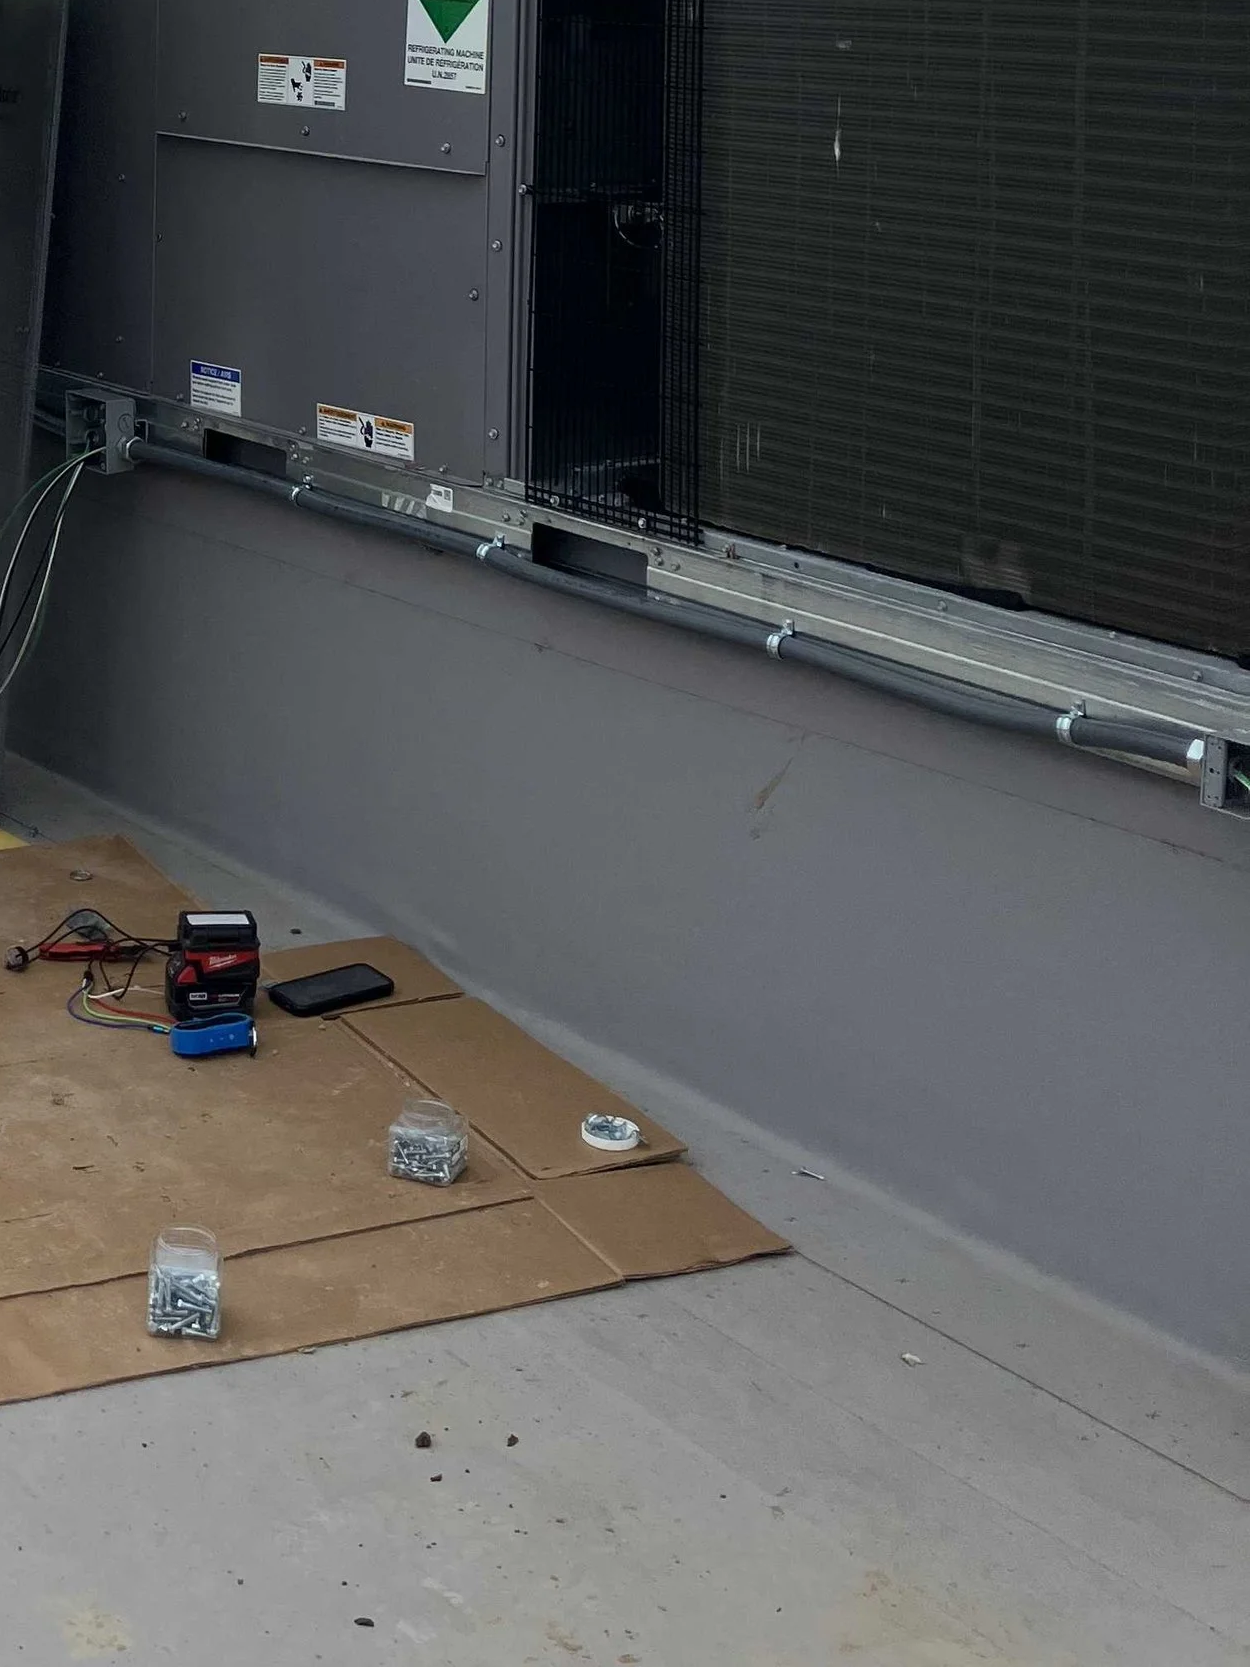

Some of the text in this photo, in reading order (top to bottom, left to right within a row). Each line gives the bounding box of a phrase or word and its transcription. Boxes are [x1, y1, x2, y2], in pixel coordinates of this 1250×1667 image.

[408, 44, 484, 60] REFRIGERATING MACHINE
[426, 57, 435, 66] DE
